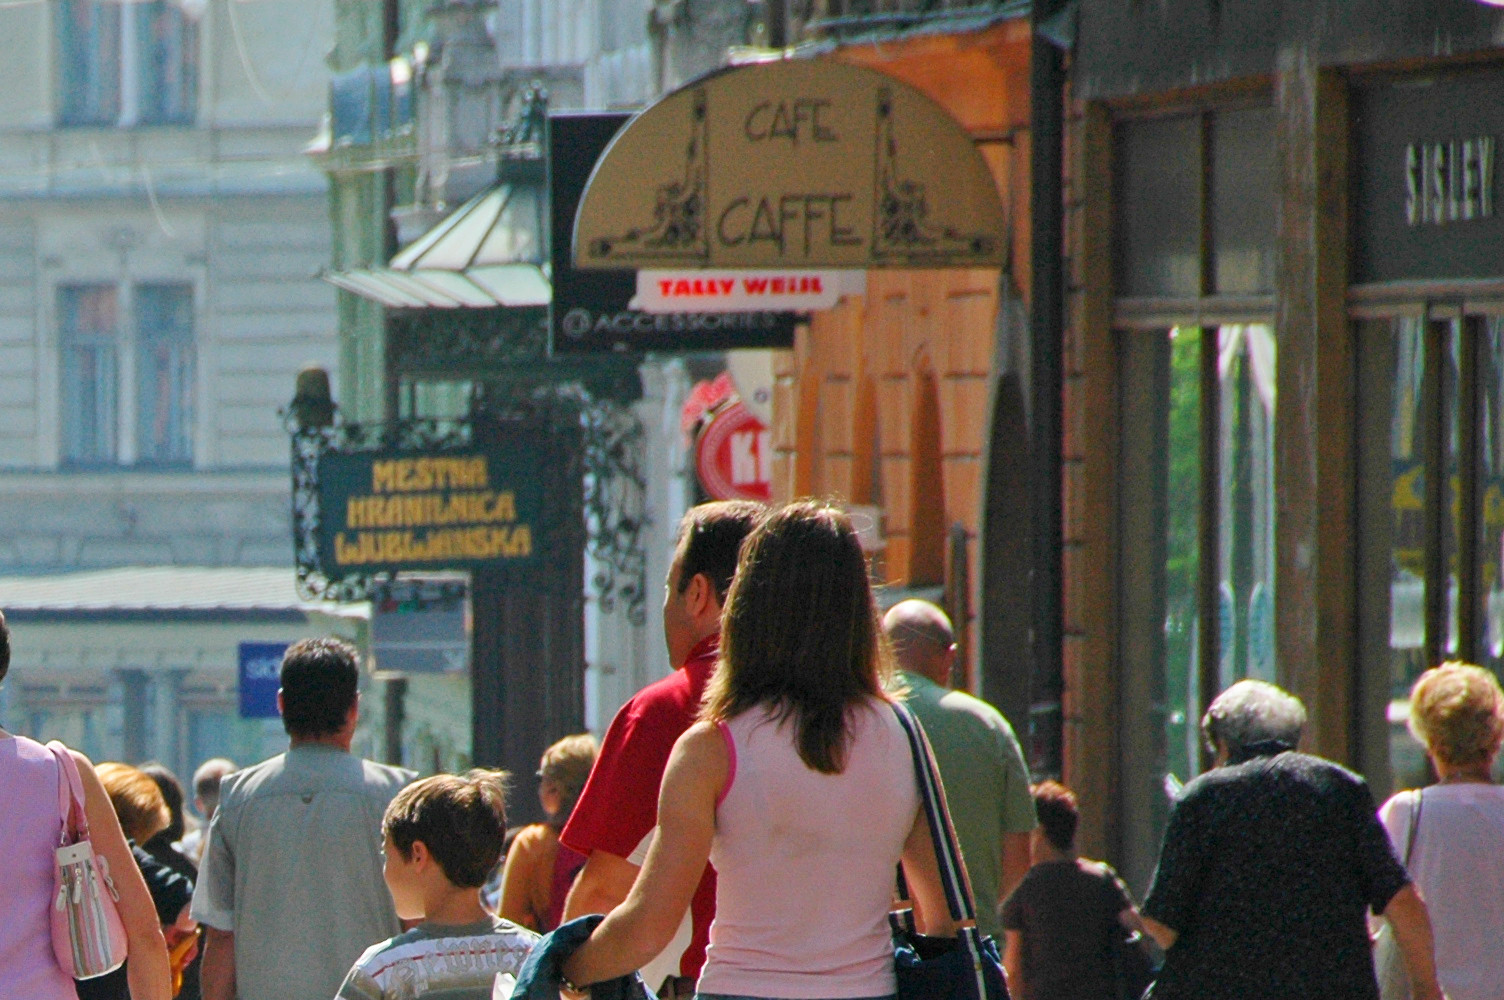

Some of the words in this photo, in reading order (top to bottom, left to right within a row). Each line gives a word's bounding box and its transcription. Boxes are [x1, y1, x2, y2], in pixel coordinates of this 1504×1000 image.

[745, 98, 839, 146] CAFE
[1405, 138, 1494, 226] SISLEY
[718, 194, 863, 256] CAFFE
[658, 279, 735, 296] TALLY
[595, 307, 778, 334] ACCESSORIES
